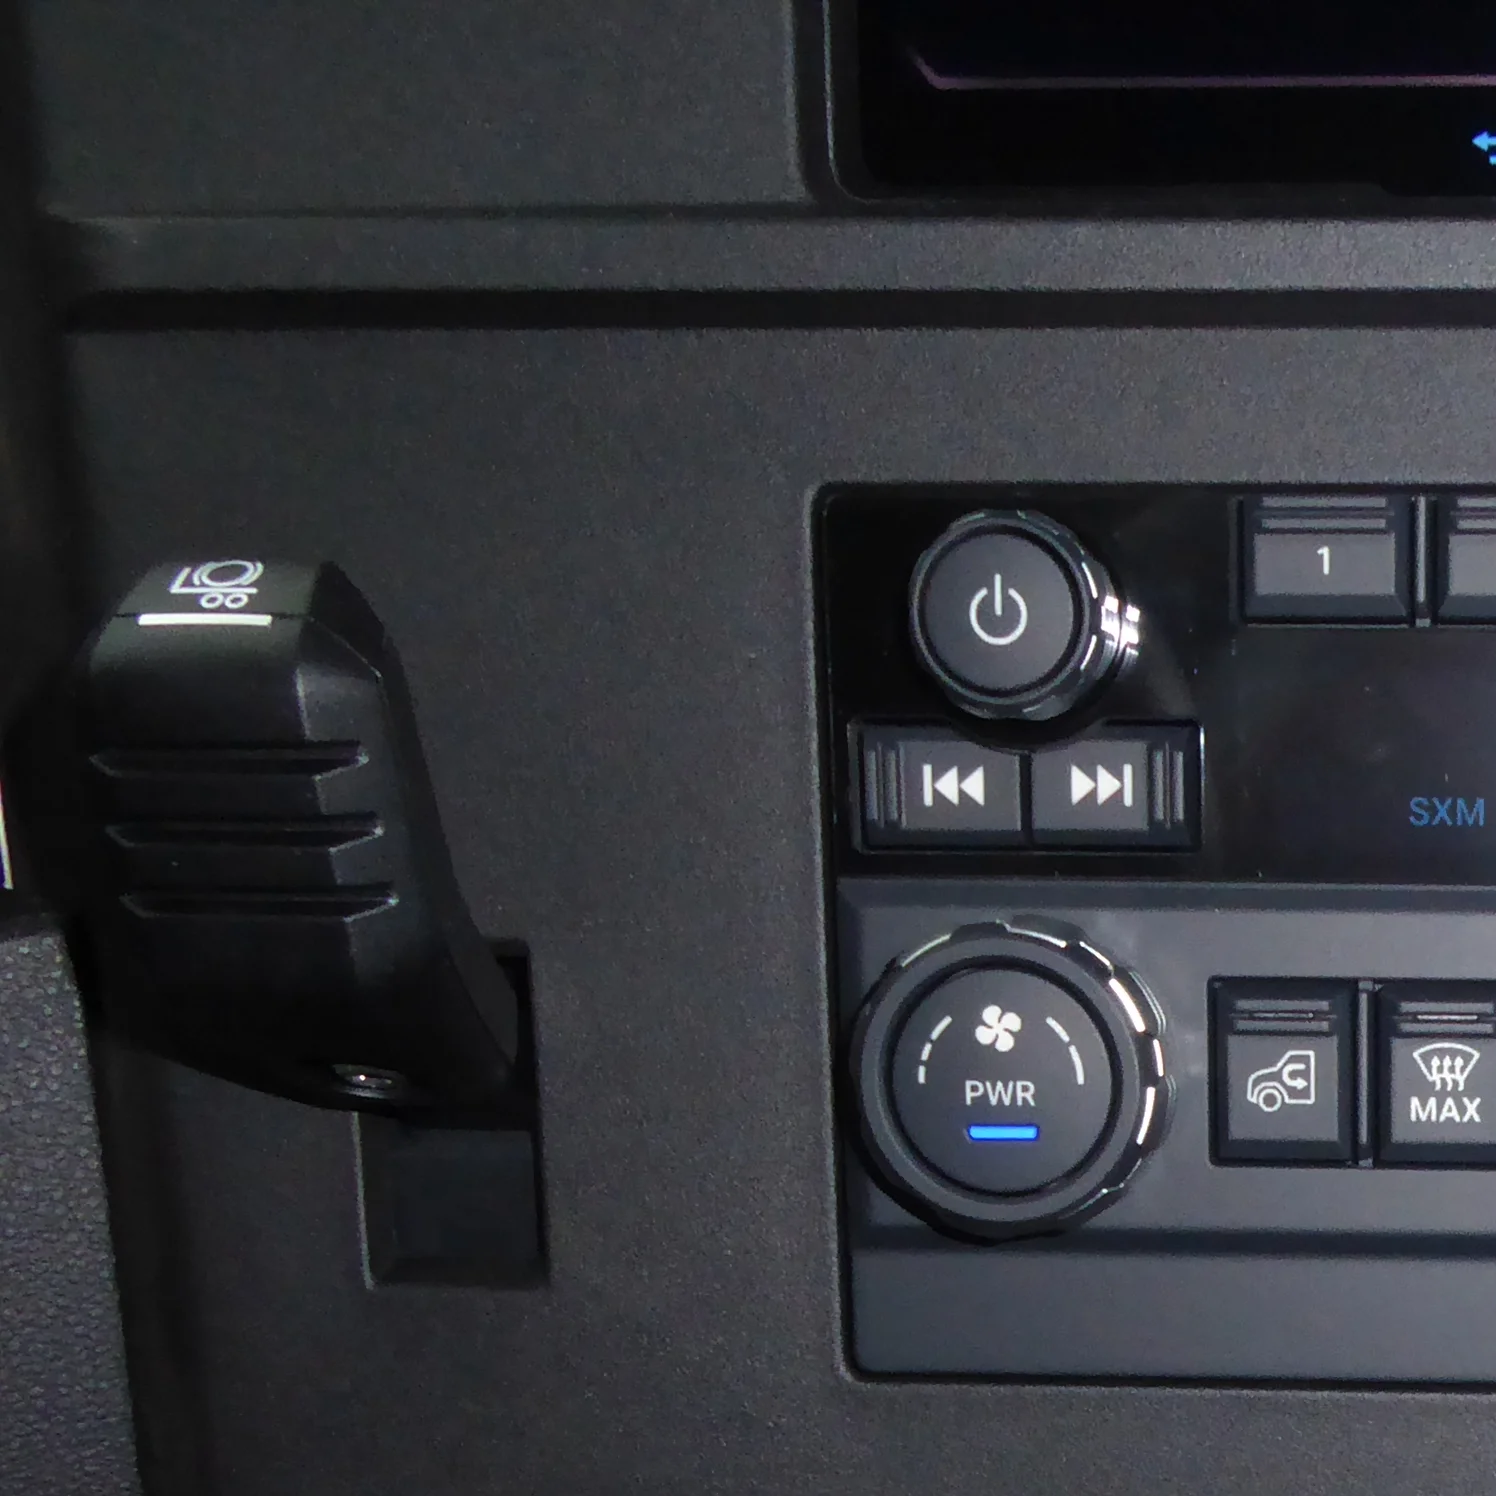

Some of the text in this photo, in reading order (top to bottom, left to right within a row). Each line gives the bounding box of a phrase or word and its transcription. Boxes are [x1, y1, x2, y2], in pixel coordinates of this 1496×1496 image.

[1317, 546, 1331, 575] 1
[1409, 797, 1486, 827] SXM
[964, 1080, 1036, 1107] PWR
[1409, 1096, 1481, 1124] MAX
